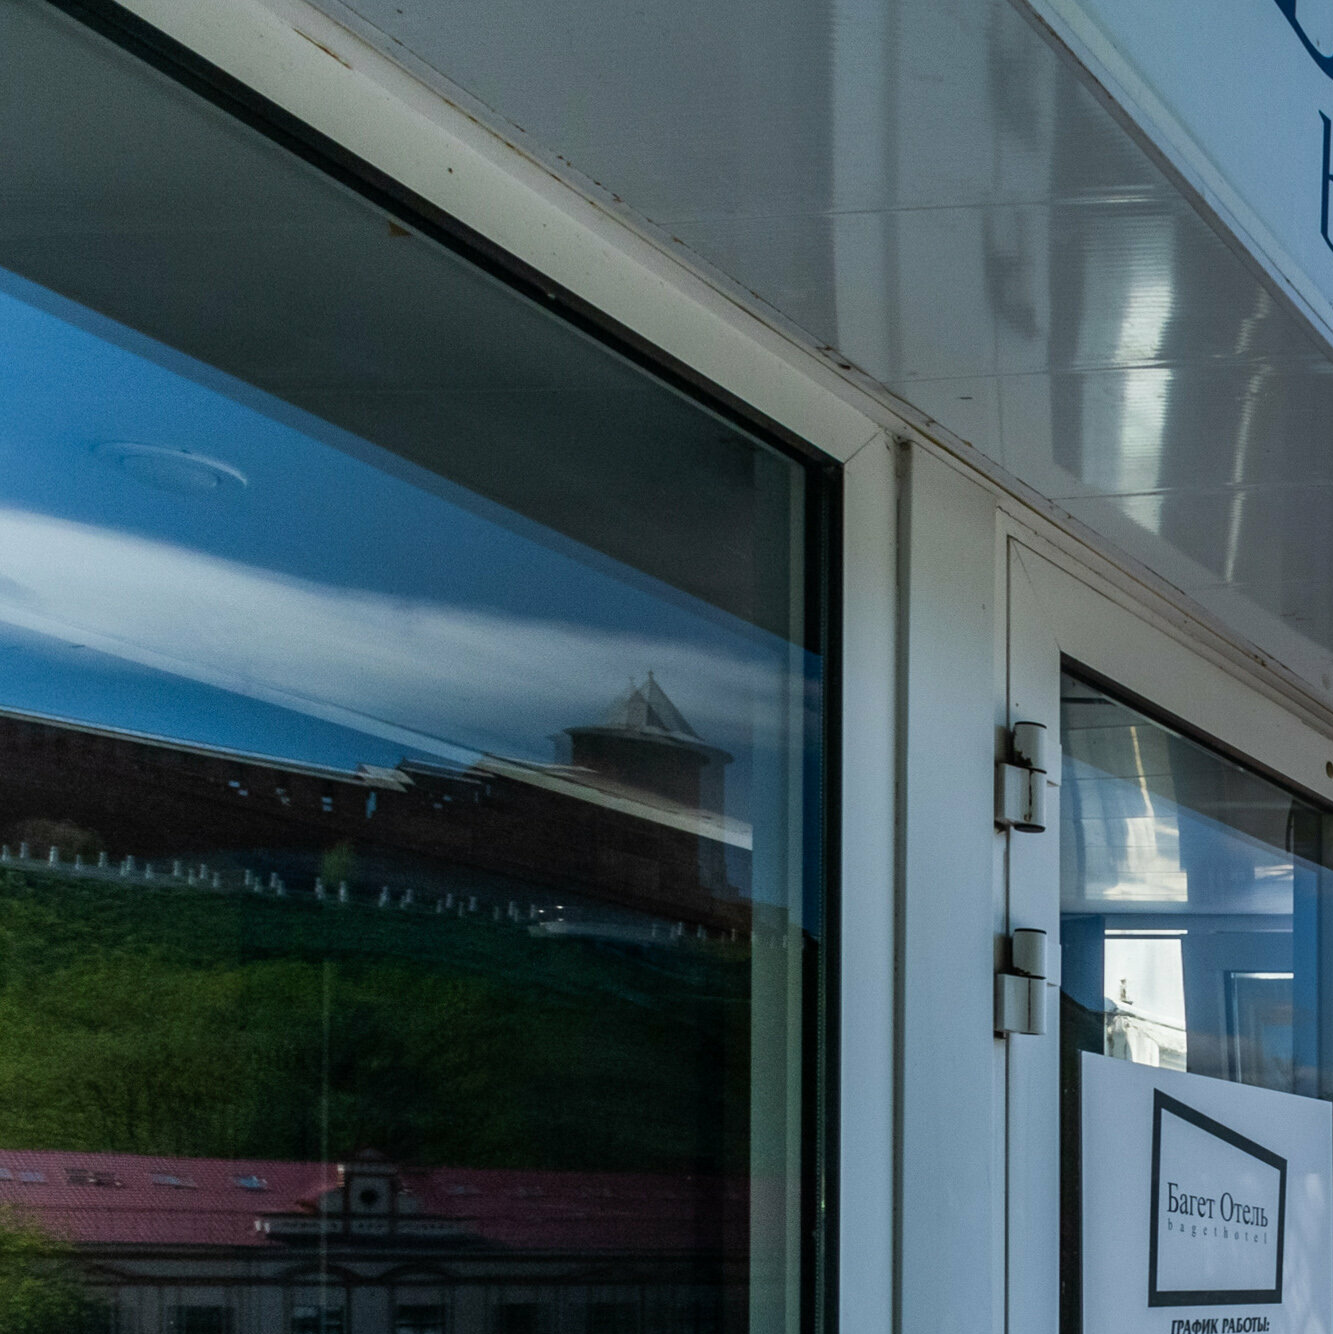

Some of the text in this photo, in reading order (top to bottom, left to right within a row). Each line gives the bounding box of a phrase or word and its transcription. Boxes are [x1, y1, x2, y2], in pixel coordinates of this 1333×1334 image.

[1167, 1181, 1269, 1228] Багет Отель
[1221, 1317, 1270, 1334] РАБОТЫ:
